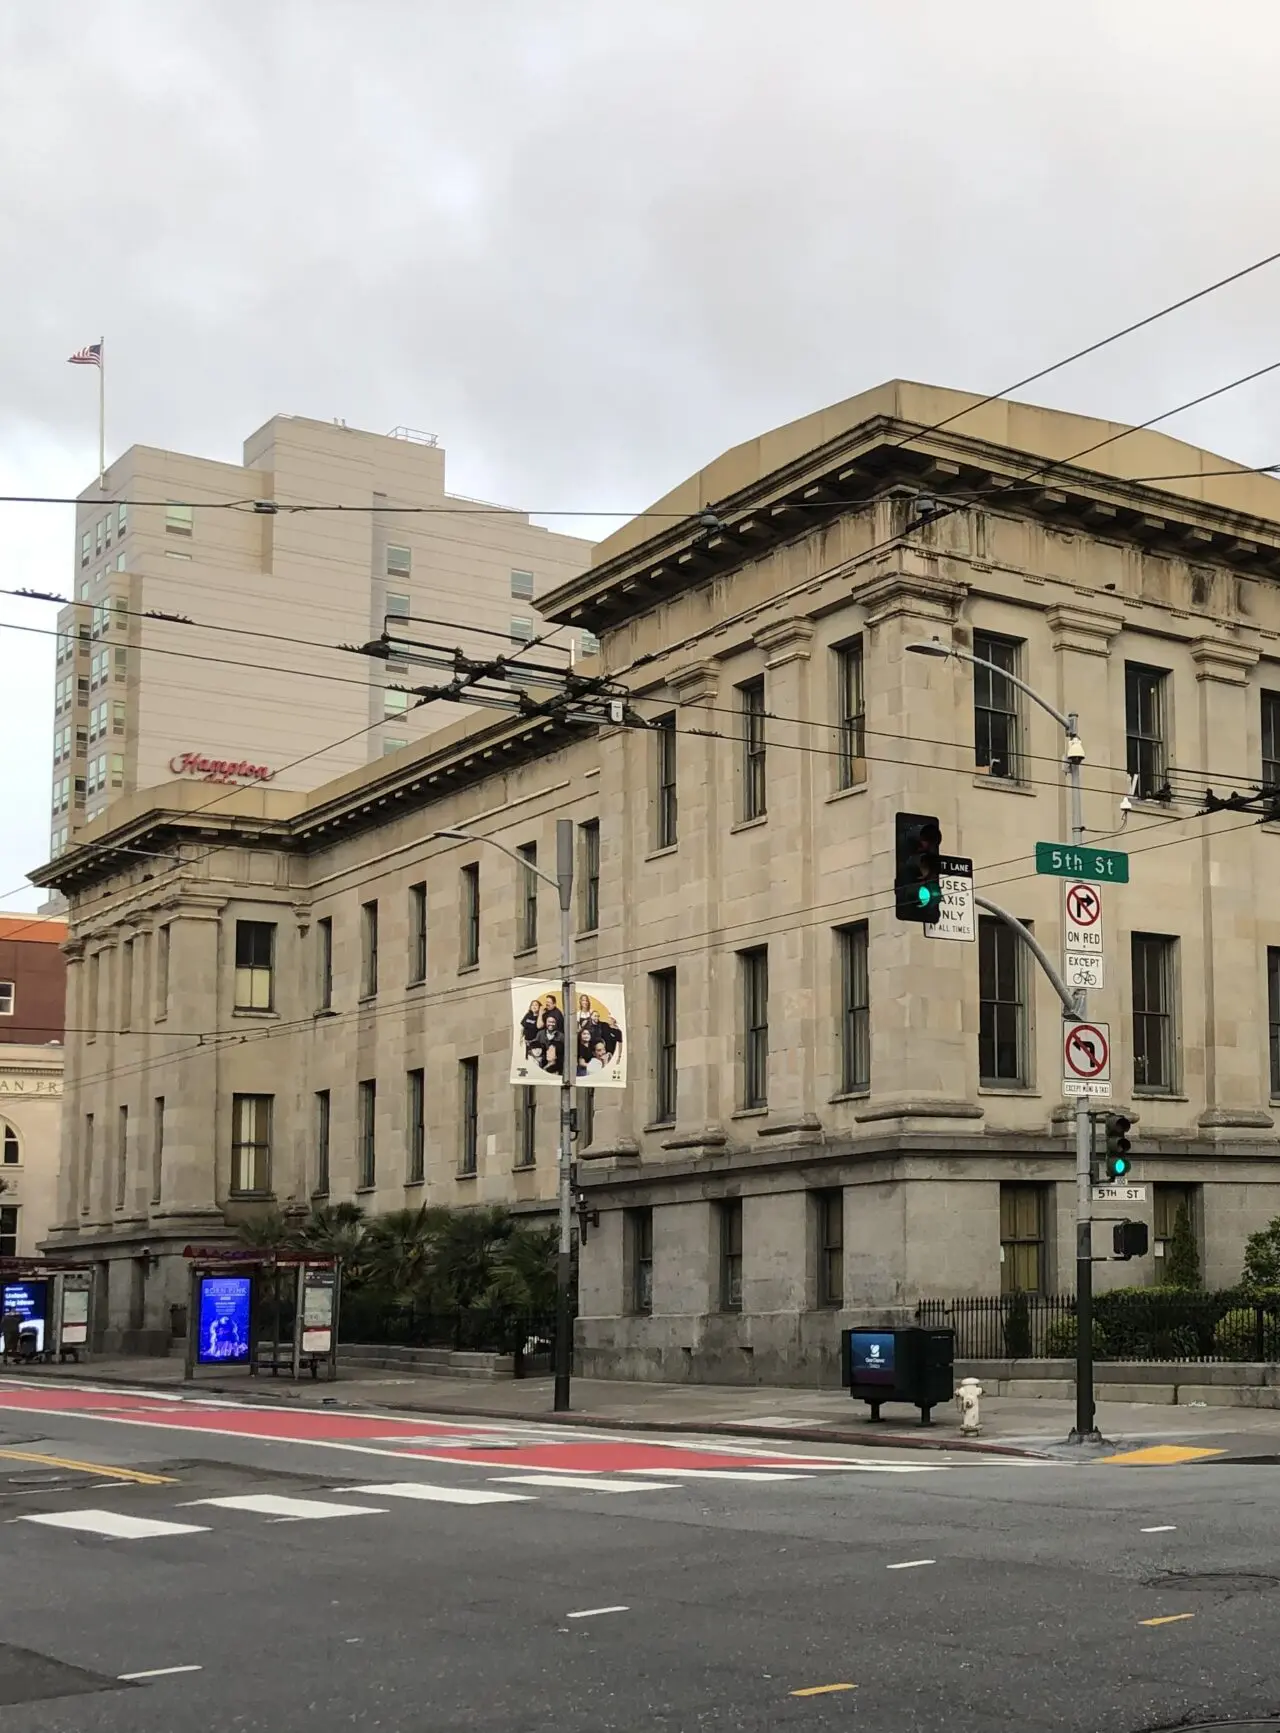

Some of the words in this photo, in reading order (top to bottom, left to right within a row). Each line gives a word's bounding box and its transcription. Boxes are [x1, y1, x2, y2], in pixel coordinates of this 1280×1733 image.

[169, 752, 275, 782] Hampton
[950, 862, 969, 873] LANE
[1052, 851, 1083, 872] 5th
[1095, 856, 1114, 875] St
[940, 895, 966, 907] AXIS
[942, 909, 964, 921] NLY
[952, 925, 971, 935] TIMES
[1067, 931, 1080, 943] ON
[1083, 932, 1100, 945] RED
[1068, 956, 1100, 968] EXCEPT
[1098, 1189, 1117, 1199] 5TH
[1126, 1189, 1139, 1199] ST
